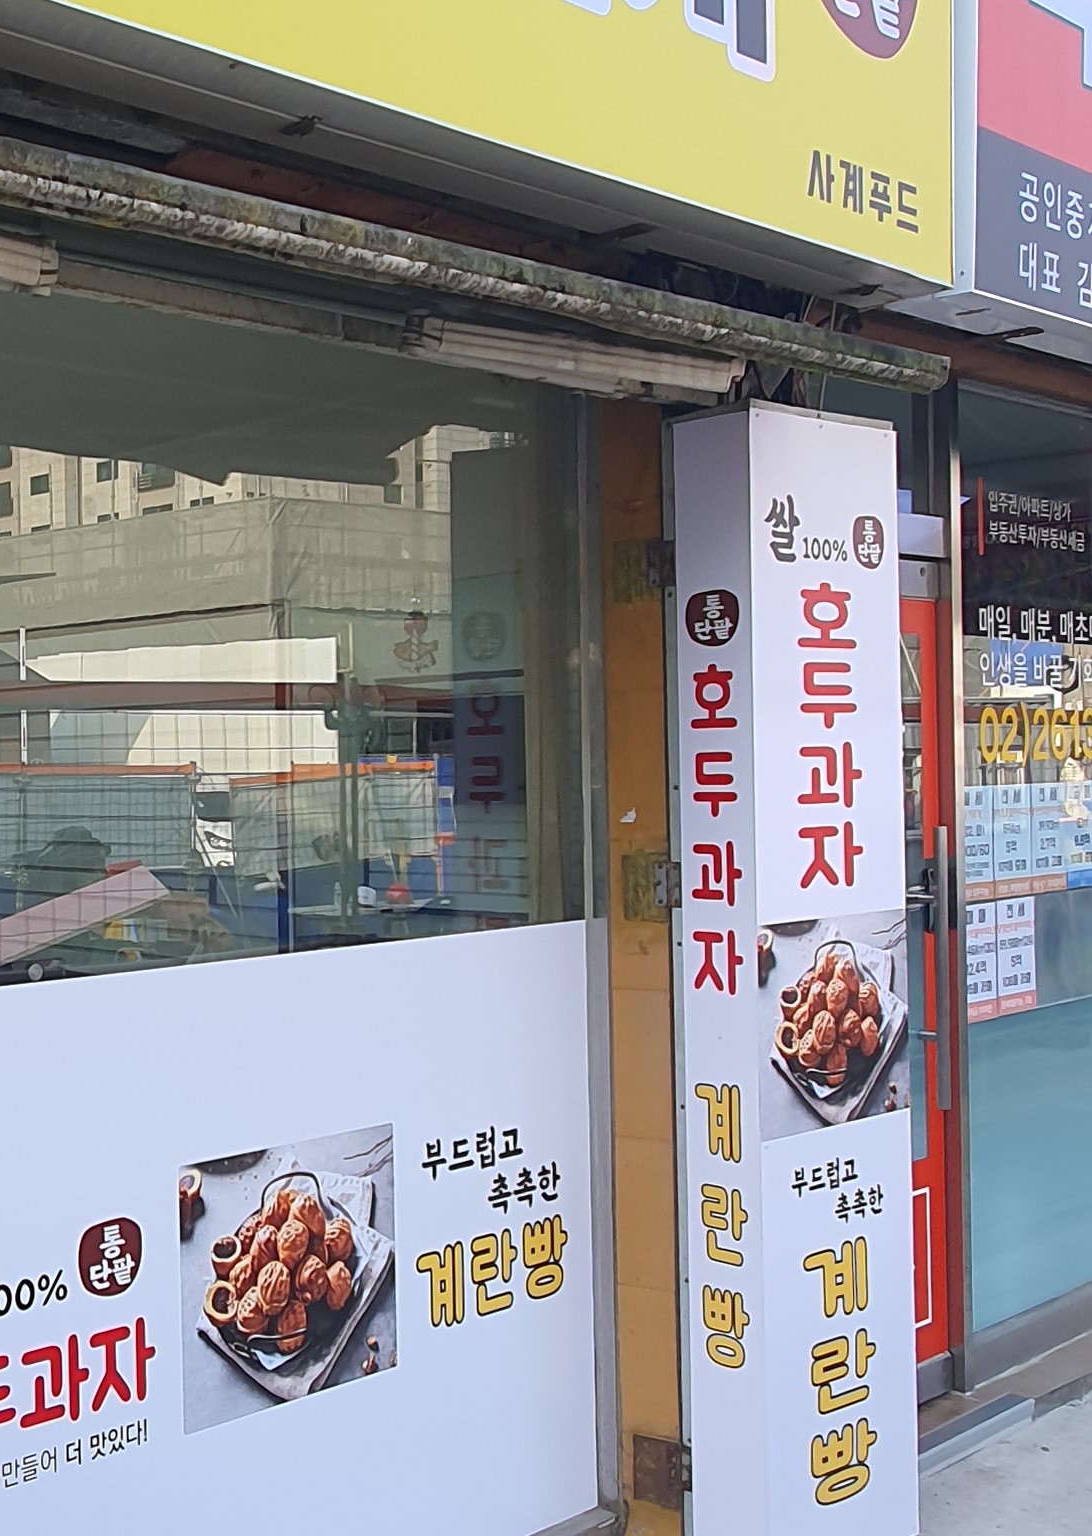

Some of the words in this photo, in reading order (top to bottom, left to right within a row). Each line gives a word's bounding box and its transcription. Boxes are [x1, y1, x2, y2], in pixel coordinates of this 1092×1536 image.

[808, 148, 919, 234] 사계푸드
[1018, 171, 1092, 240] 공인중
[1019, 242, 1062, 294] 대표
[765, 493, 801, 563] 쌀
[803, 536, 848, 563] 100%
[1060, 610, 1092, 643] 매초
[979, 651, 1029, 688] 인생을
[1033, 653, 1063, 689] 바꿀
[797, 582, 864, 890] 호두과자
[690, 664, 745, 997] 호두과자
[420, 1125, 524, 1177] 부드럽고
[791, 1158, 859, 1197] 부드럽고
[487, 1161, 562, 1215] 촉촉한
[834, 1182, 885, 1224] 촉촉한
[695, 1082, 750, 1369] 계란빵
[415, 1213, 570, 1329] 계란빵
[802, 1235, 877, 1507] 계란빵
[0, 1444, 60, 1490] 만들어
[64, 1436, 84, 1467] 더
[88, 1418, 150, 1464] 맛있다!
